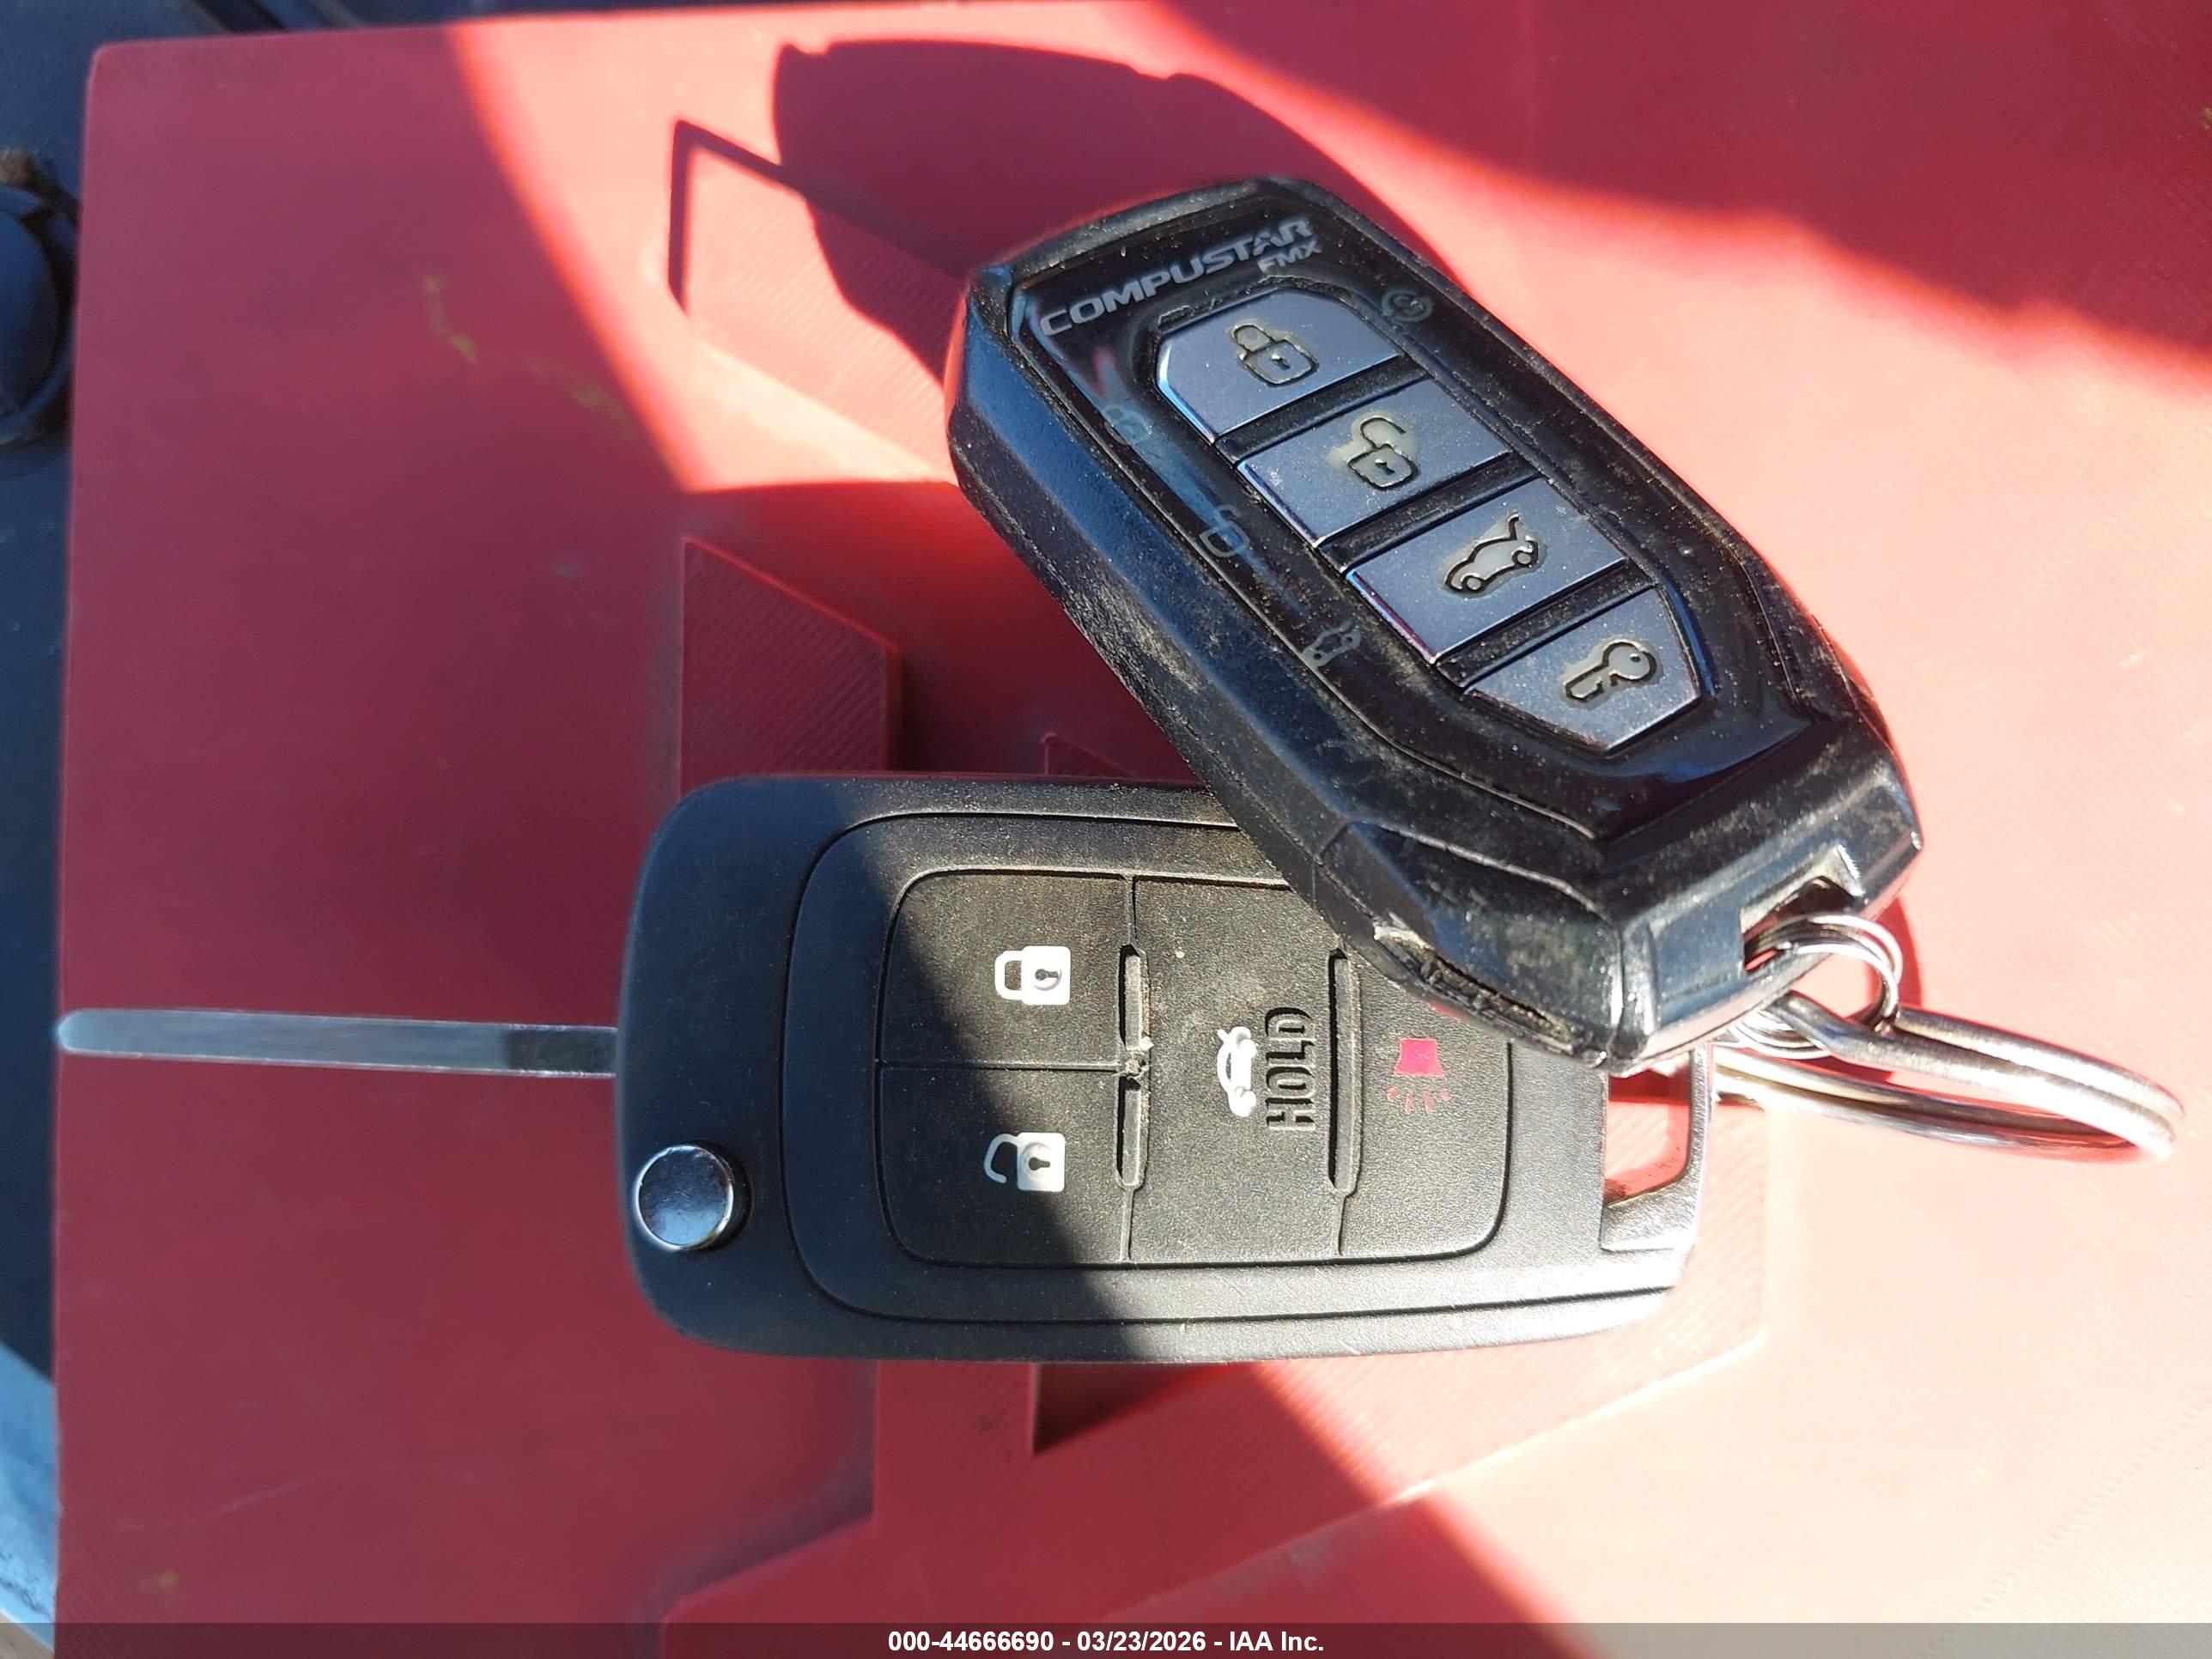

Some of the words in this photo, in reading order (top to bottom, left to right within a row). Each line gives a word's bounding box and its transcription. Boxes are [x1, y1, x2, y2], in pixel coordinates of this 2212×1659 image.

[1039, 220, 1313, 337] COMPUSTAR
[1256, 240, 1322, 275] FMX
[1264, 1006, 1317, 1132] HOLD
